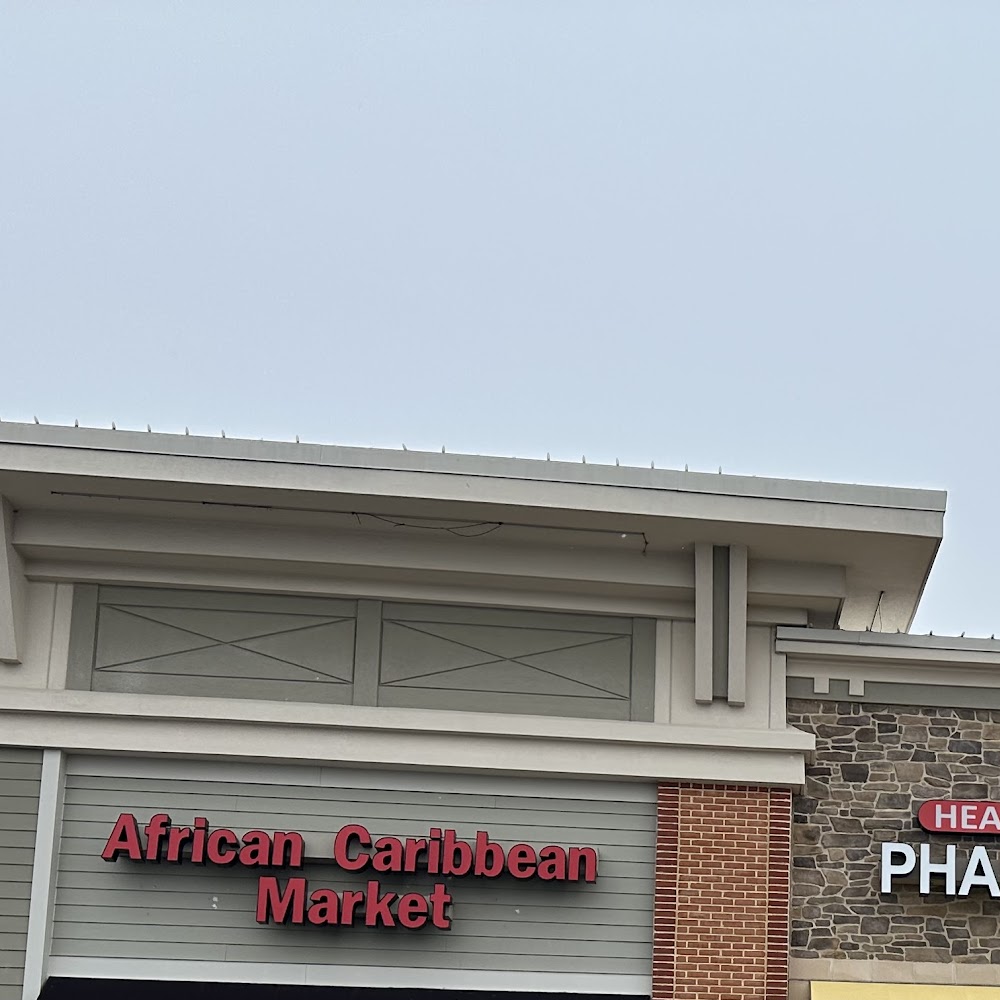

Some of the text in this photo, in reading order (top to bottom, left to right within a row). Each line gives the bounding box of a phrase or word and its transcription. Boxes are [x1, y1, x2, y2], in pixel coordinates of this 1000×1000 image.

[102, 813, 598, 884] African Caribbean
[256, 876, 454, 931] Market
